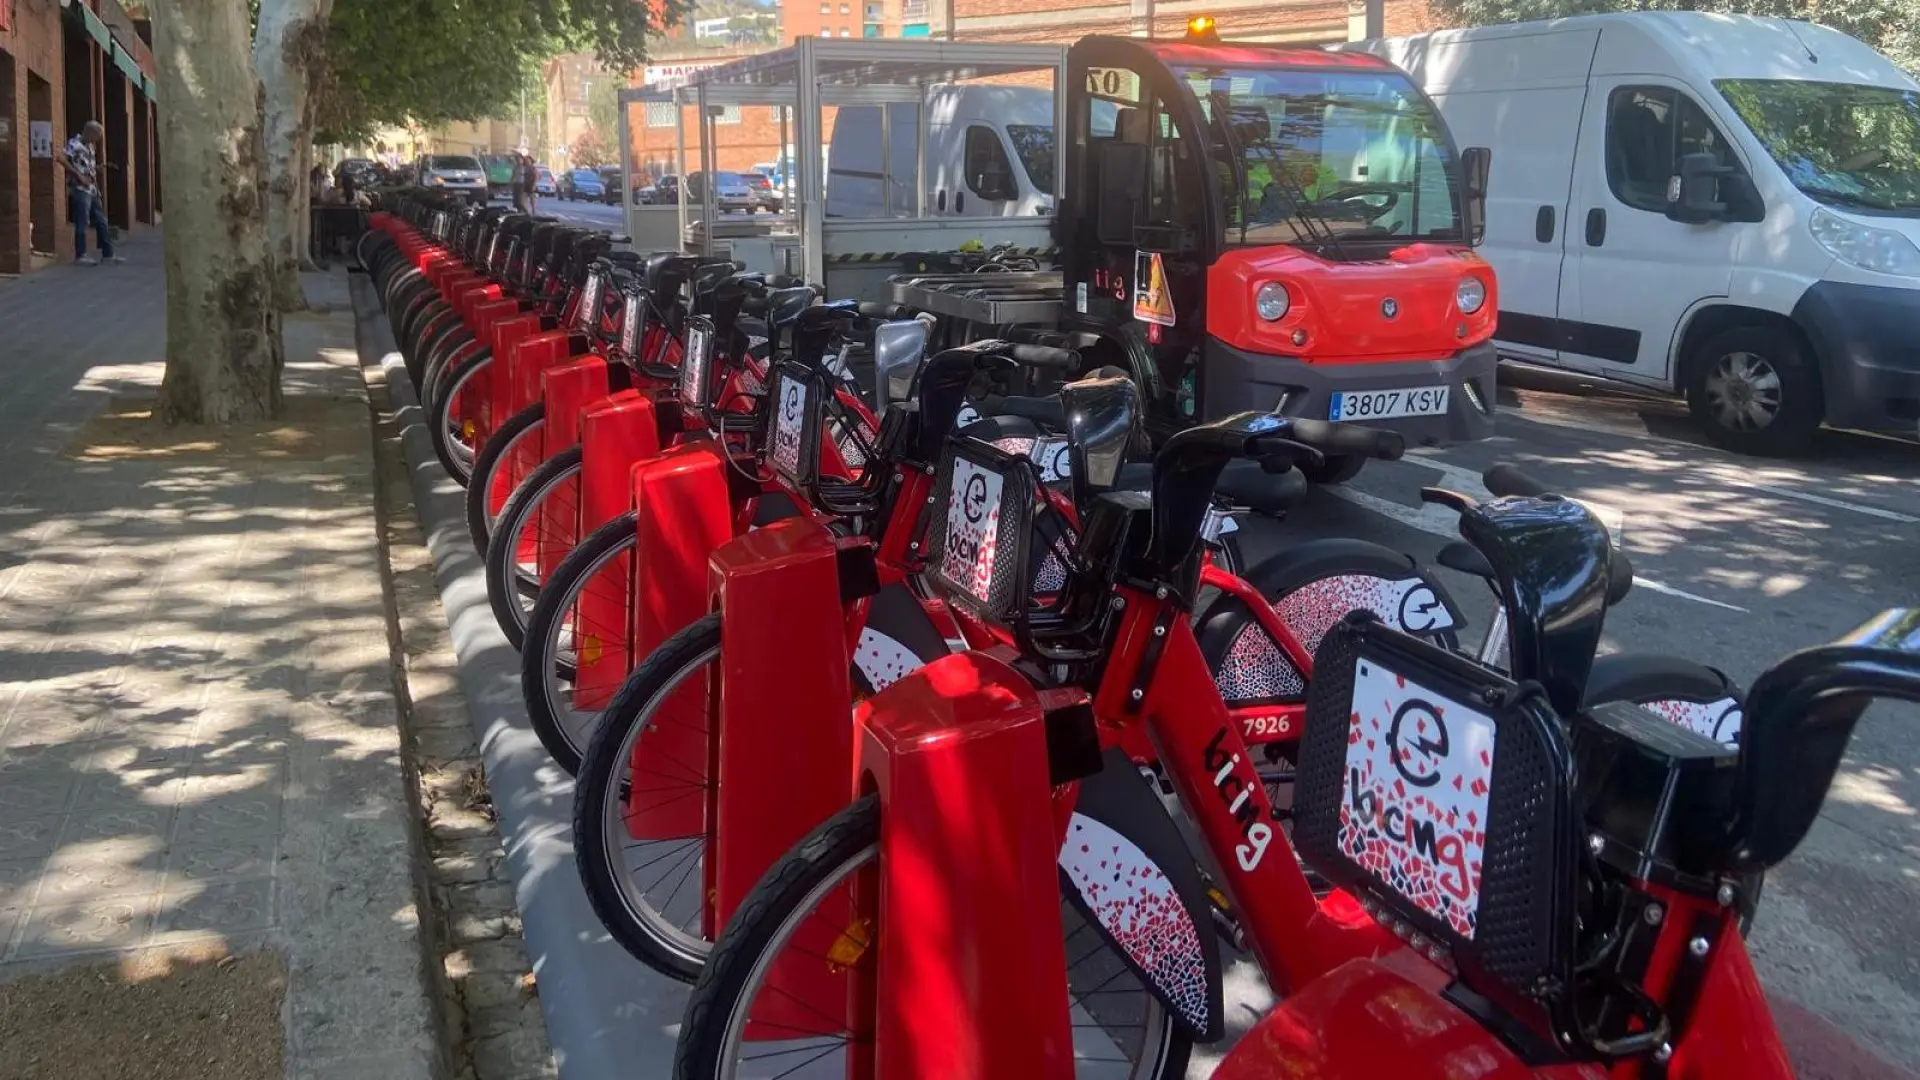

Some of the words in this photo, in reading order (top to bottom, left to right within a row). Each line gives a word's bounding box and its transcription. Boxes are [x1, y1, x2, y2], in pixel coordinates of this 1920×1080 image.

[1345, 393, 1400, 416] 3807
[1405, 390, 1445, 413] KSV
[1243, 715, 1290, 737] 7926
[1205, 725, 1272, 872] bicing
[1350, 767, 1470, 901] bicing
